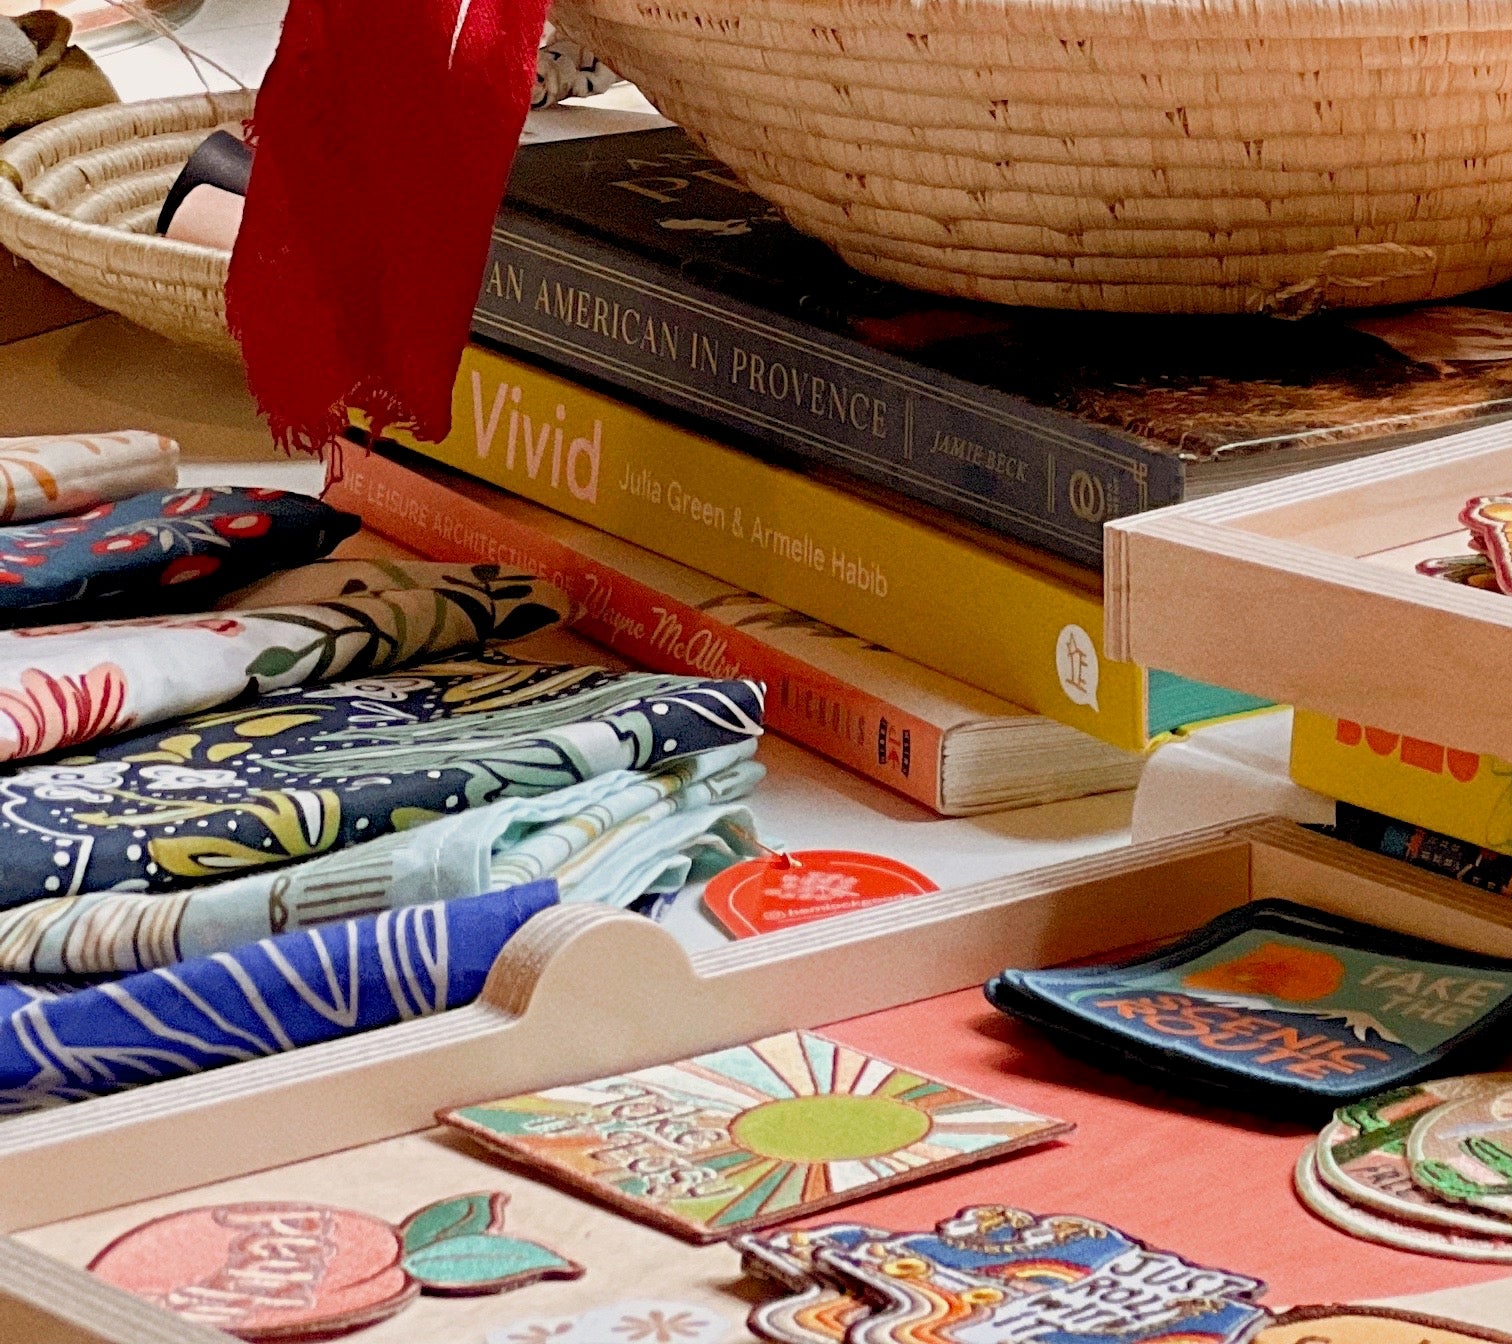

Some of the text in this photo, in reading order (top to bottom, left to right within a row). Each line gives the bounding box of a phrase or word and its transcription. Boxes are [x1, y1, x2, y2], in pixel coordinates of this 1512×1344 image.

[487, 259, 888, 439] AN AMERICAN IN PROVENCE
[470, 369, 602, 505] Vivid
[930, 430, 1028, 482] JAMIE BECK
[367, 476, 429, 528] LEISURE
[617, 463, 889, 600] Julia Green & Armelle Habib
[1359, 965, 1500, 1005] TAKE
[1382, 992, 1472, 1027] THE
[1150, 992, 1392, 1074] SCENIC
[1066, 1276, 1174, 1322] ROLL
[1111, 1252, 1246, 1296] JUST
